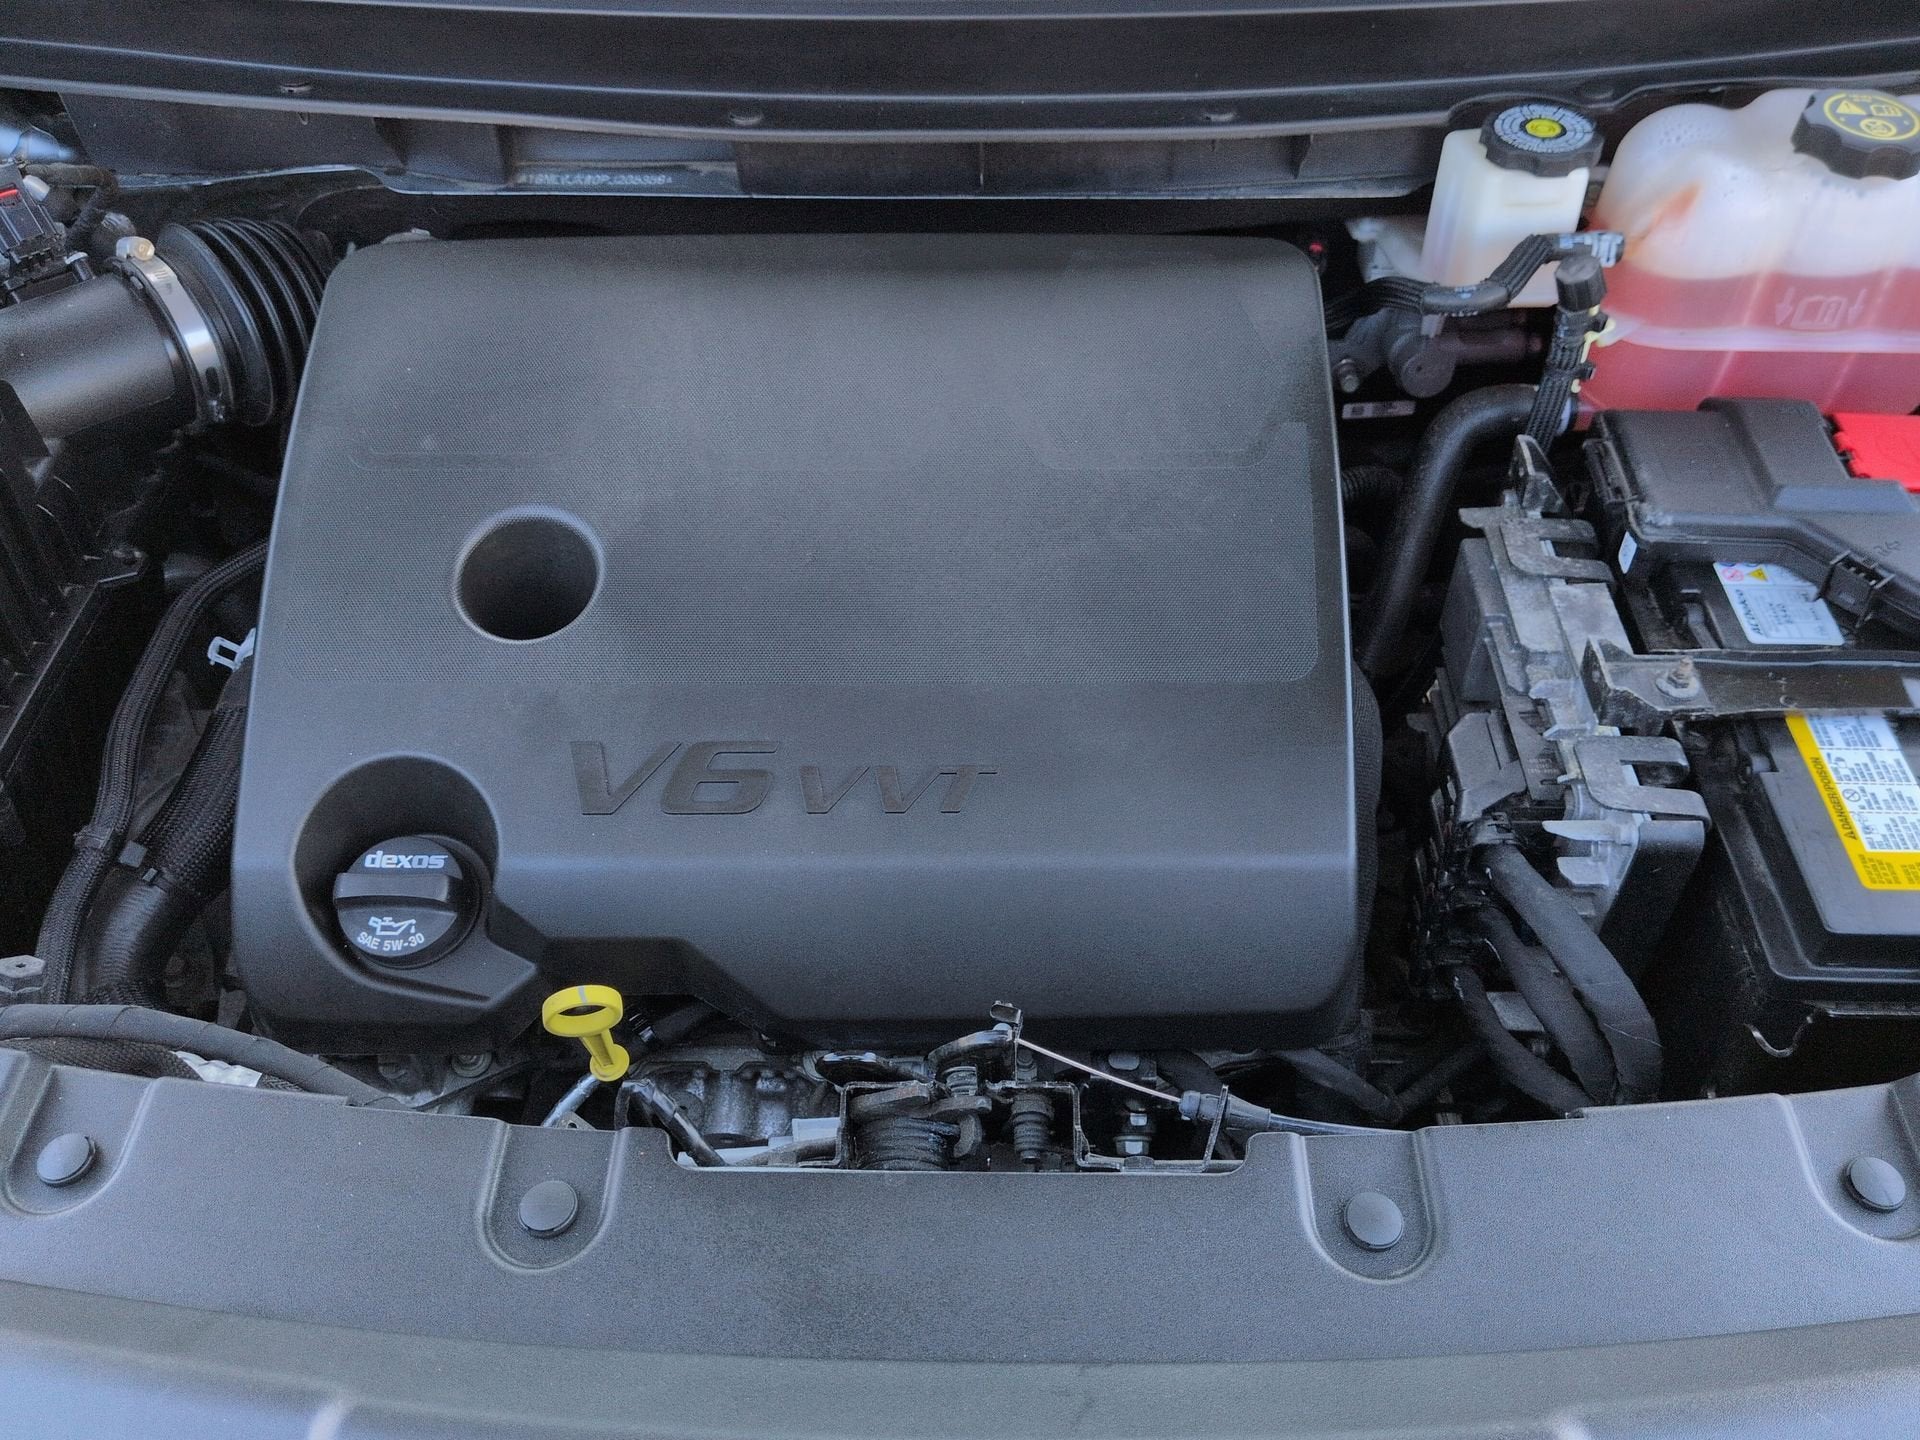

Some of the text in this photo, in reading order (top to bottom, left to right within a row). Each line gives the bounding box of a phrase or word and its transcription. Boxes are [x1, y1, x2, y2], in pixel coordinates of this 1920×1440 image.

[570, 741, 998, 815] V6 VVT
[364, 850, 448, 869] dexos
[357, 931, 425, 951] SAE 5W-30
